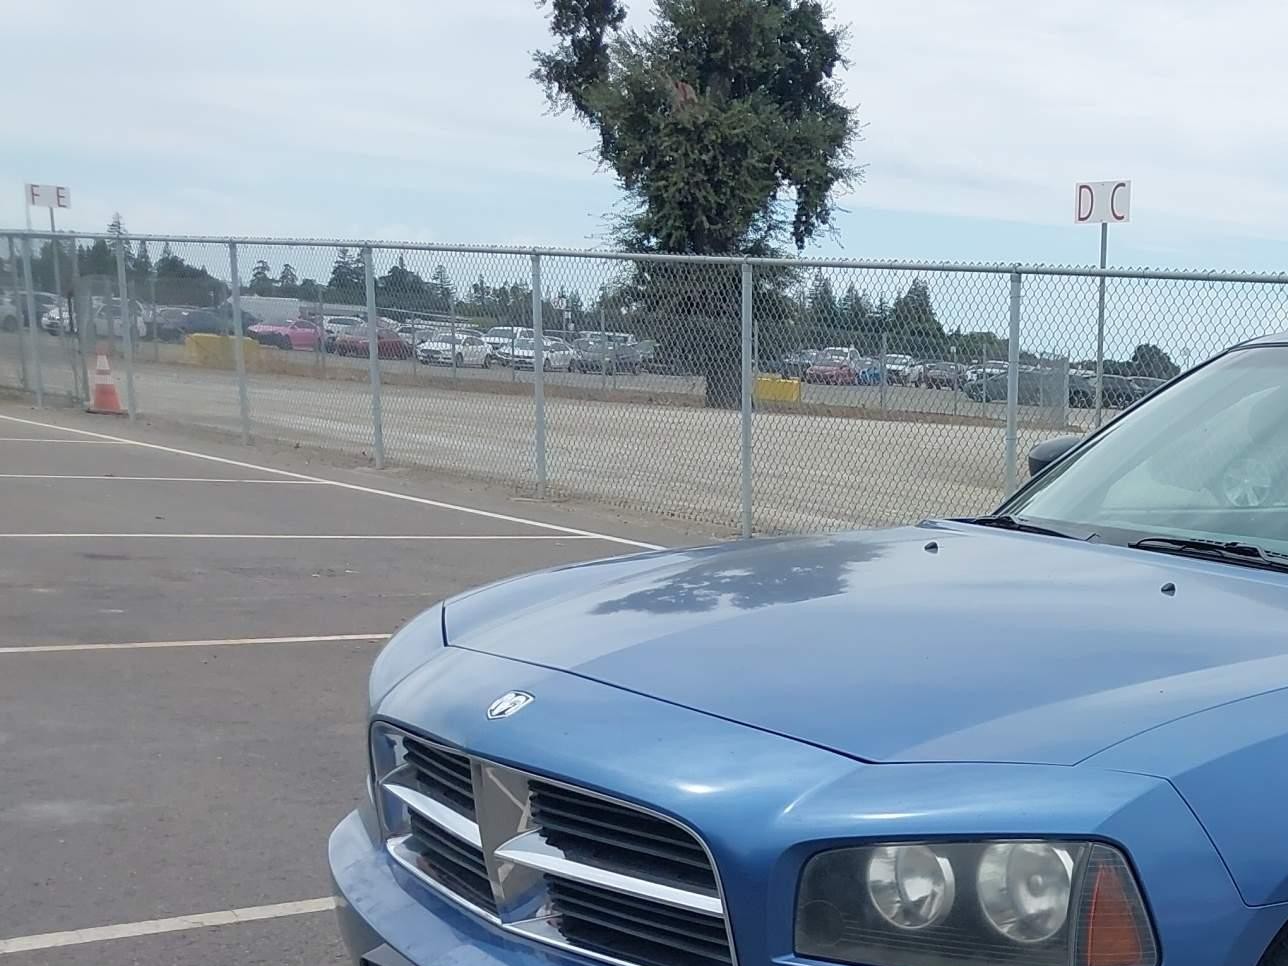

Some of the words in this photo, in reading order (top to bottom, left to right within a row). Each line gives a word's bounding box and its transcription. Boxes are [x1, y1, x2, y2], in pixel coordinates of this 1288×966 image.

[30, 184, 40, 206] F
[56, 186, 67, 208] E
[1078, 185, 1094, 221] D
[1110, 183, 1126, 221] C
